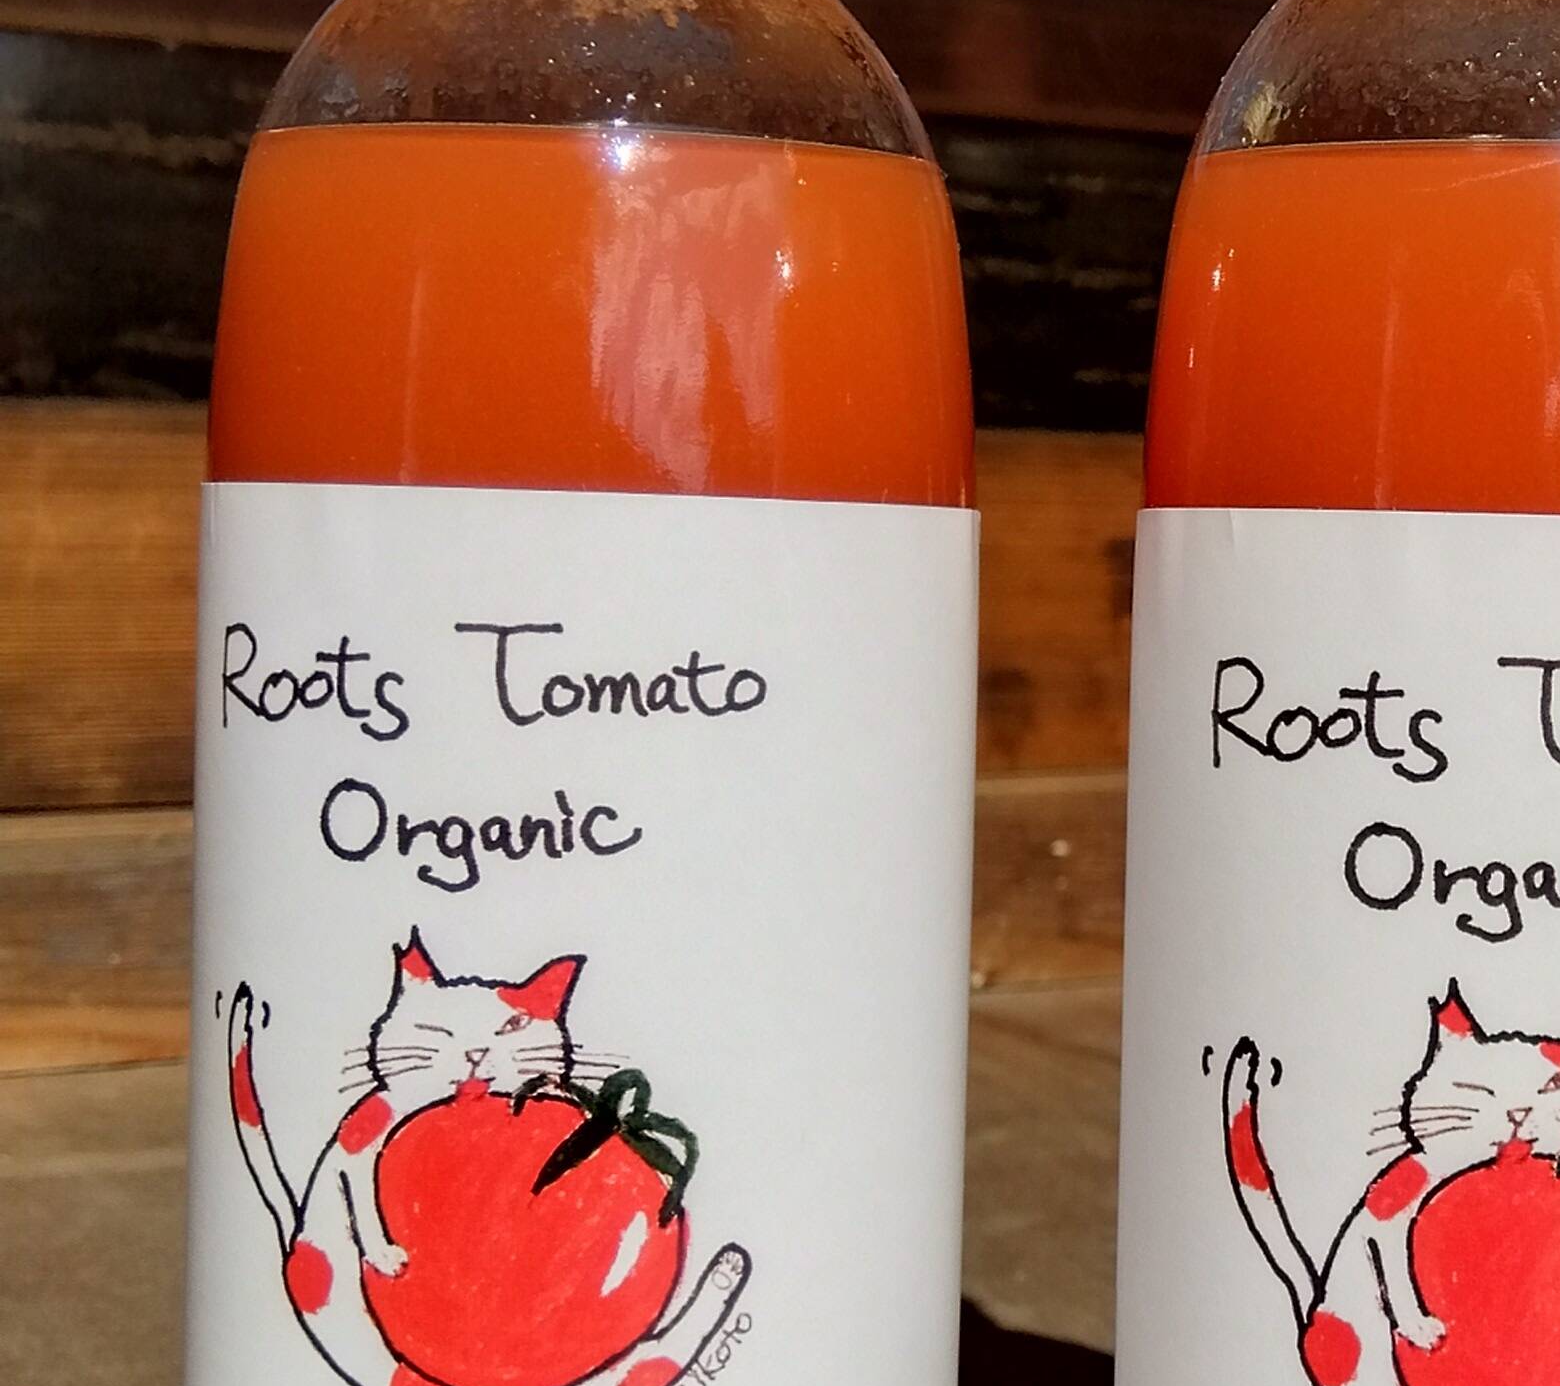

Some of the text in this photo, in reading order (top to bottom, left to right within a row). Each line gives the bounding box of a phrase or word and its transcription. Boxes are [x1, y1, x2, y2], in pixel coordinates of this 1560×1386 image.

[221, 622, 768, 743] Roots Tomato
[1210, 656, 1449, 784] Roots
[319, 777, 643, 894] Organic
